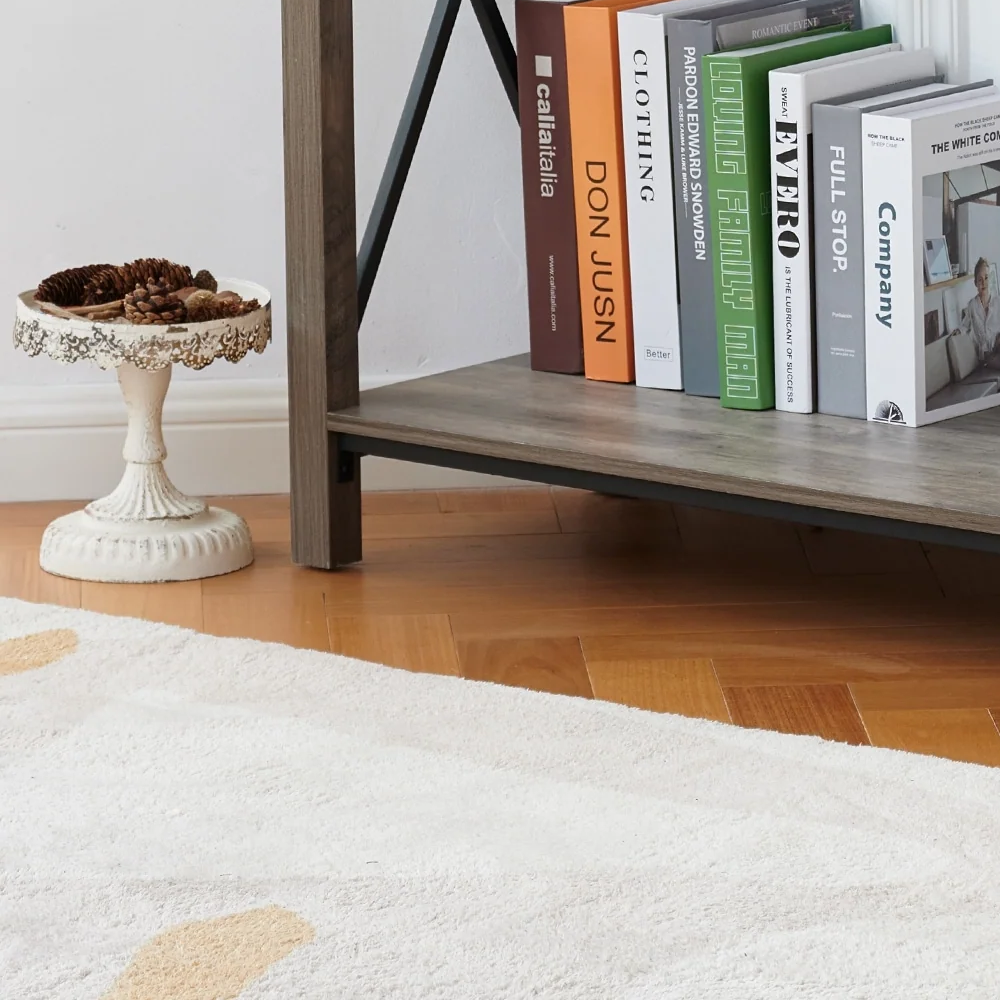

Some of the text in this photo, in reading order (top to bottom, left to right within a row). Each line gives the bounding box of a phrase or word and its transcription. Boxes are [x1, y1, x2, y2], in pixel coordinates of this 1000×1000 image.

[752, 16, 818, 40] ROMANTIC EVENT
[536, 83, 558, 198] caliaitalia
[633, 49, 655, 203] CLOTHING
[684, 47, 706, 260] PARDON EDWARD SNOWDEN
[931, 141, 949, 154] THE
[952, 135, 981, 150] WHITE
[775, 118, 801, 258] EVERO
[830, 145, 848, 273] FULL STOP.
[585, 161, 617, 343] DON JUSN
[717, 189, 754, 310] FAMILY
[785, 266, 791, 274] IS
[874, 202, 897, 329] Company
[646, 349, 671, 360] Better
[787, 347, 793, 359] OF
